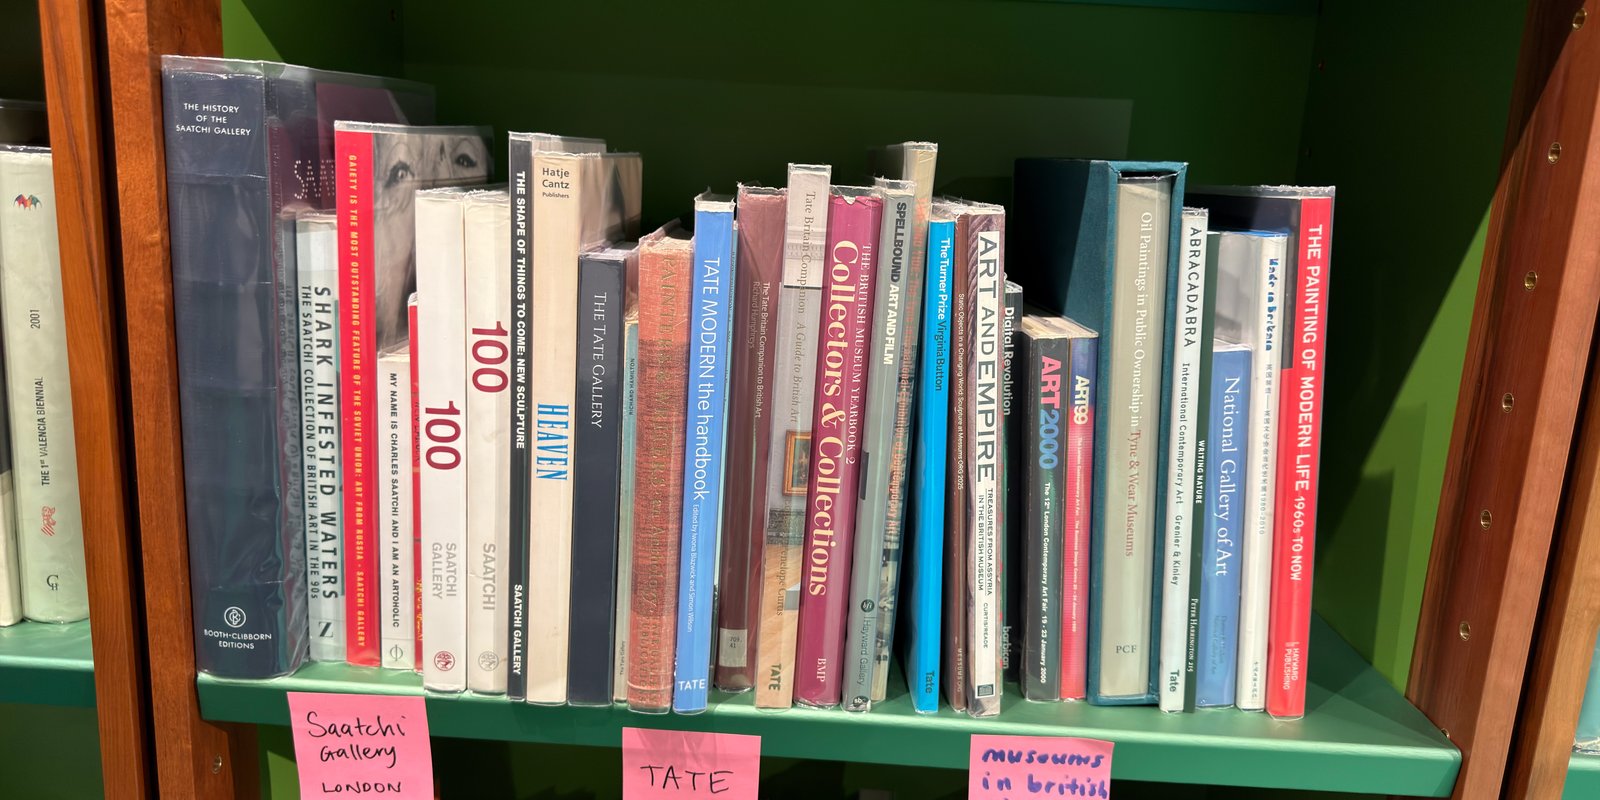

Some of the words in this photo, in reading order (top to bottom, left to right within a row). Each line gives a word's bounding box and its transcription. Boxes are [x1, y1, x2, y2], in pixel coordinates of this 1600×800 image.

[184, 103, 199, 111] THE
[202, 104, 240, 113] HISTORY
[211, 116, 227, 124] THE
[176, 124, 211, 133] SAATCHI
[214, 127, 251, 136] GALLERY
[349, 155, 358, 190] GAIETY
[517, 171, 526, 195] THE
[542, 167, 570, 179] Hatje
[542, 179, 570, 189] Cantz
[350, 195, 357, 205] IS
[350, 210, 358, 227] THE
[517, 197, 526, 236] SHAPE
[1140, 212, 1153, 231] Oil
[350, 232, 359, 257] MOST
[517, 239, 526, 255] OF
[890, 202, 907, 282] SPELLBOUND
[940, 238, 951, 259] The
[1307, 225, 1323, 260] THE
[861, 244, 872, 271] THE
[979, 236, 998, 299] ART
[1135, 235, 1151, 291] Paintings
[517, 257, 526, 300] THINGS
[703, 257, 720, 294] TATE
[762, 282, 771, 296] The
[938, 259, 950, 293] Turner
[1184, 227, 1202, 347] ABRACADABRA
[301, 285, 312, 307] THE
[351, 262, 360, 327] OUTSTANDING
[751, 281, 760, 308] Richard
[761, 298, 770, 311] Tate
[856, 274, 870, 324] BRITISH
[888, 284, 900, 309] ART
[937, 294, 948, 320] Prize
[1136, 294, 1149, 306] in
[1303, 266, 1321, 344] PAINTING
[30, 309, 41, 329] 2001
[517, 303, 526, 318] TO
[824, 241, 859, 397] Collectors
[886, 310, 898, 336] AND
[957, 312, 965, 335] Objects
[302, 313, 313, 363] SAATCHI
[314, 286, 333, 367] SHARK
[516, 320, 526, 355] COME:
[699, 299, 718, 378] MODERN
[934, 320, 947, 356] Virginia
[981, 306, 995, 356] AND
[1134, 309, 1147, 346] Public
[352, 331, 361, 371] FEATURE
[473, 321, 509, 393] 100
[852, 328, 866, 383] MUSEUM
[883, 337, 895, 365] FILM
[956, 347, 965, 376] Changing
[1301, 349, 1316, 371] OF
[353, 374, 361, 386] OF
[390, 373, 398, 387] MY
[516, 358, 525, 384] NEW
[935, 358, 946, 392] Button
[1003, 351, 1014, 417] Revolution
[1128, 349, 1146, 413] Ownership
[304, 370, 316, 440] COLLECTION
[353, 390, 361, 407] THE
[390, 390, 398, 417] NAME
[698, 383, 715, 410] the
[755, 385, 765, 406] British
[516, 385, 525, 448] SCULPTURE
[821, 402, 847, 429] &
[847, 387, 861, 452] YEARBOOK
[956, 397, 964, 425] Sculpture
[977, 361, 996, 483] EMPIRE
[1131, 416, 1142, 427] in
[1220, 376, 1241, 452] National
[1297, 377, 1315, 448] MODERN
[37, 417, 48, 458] VALENCIA
[354, 411, 362, 442] SOVIET
[391, 421, 398, 430] IS
[425, 400, 462, 471] 100
[306, 446, 316, 460] OF
[317, 383, 335, 497] INFESTED
[536, 403, 571, 481] HEAVEN
[1128, 430, 1142, 458] Tyne
[354, 446, 363, 477] UNION:
[391, 433, 399, 476] CHARLES
[693, 416, 714, 500] handbook
[1129, 460, 1140, 470] &
[1175, 424, 1187, 487] Contemporary
[1197, 440, 1206, 473] WRITING
[41, 470, 50, 486] THE
[307, 465, 318, 509] BRITISH
[1128, 473, 1139, 501] Wear
[1295, 455, 1311, 491] LIFE
[355, 481, 363, 497] ART
[391, 478, 400, 517] SAATCHI
[978, 495, 986, 505] IN
[1176, 490, 1184, 505] Art
[1195, 475, 1204, 504] NATURE
[1213, 459, 1237, 521] Gallery
[309, 514, 318, 535] ART
[355, 502, 364, 525] FROM
[809, 437, 844, 596] Collections
[978, 505, 986, 521] THE
[1043, 511, 1051, 536] London
[391, 519, 399, 539] AND
[1125, 504, 1138, 557] Museums
[1173, 515, 1183, 548] Grenier
[1215, 527, 1233, 547] of
[309, 540, 318, 552] IN
[320, 511, 338, 600] WATERS
[356, 529, 364, 560] RUSSIA
[392, 547, 400, 561] AM
[986, 538, 994, 561] FROM
[1292, 536, 1304, 552] TO
[310, 557, 319, 576] THE
[392, 563, 400, 577] AN
[432, 542, 444, 599] GALLERY
[446, 543, 458, 597] SAATCHI
[1041, 537, 1050, 584] Contemporary
[1214, 549, 1232, 577] Art
[1290, 556, 1303, 581] NOW
[311, 581, 320, 600] 90s
[357, 571, 365, 607] SAATCHI
[482, 543, 497, 611] SAATCHI
[689, 580, 697, 592] and
[392, 580, 400, 628] ARTOHOLIC
[513, 585, 523, 627] SAATCHI
[357, 610, 366, 646] GALLERY
[219, 640, 255, 650] EDITIONS
[513, 630, 522, 675] GALLERY
[1040, 639, 1048, 665] January
[1116, 644, 1137, 654] PCF
[769, 663, 782, 691] TATE
[816, 658, 827, 682] BMP
[1283, 648, 1292, 690] PUBLISHING
[1291, 648, 1300, 681] HAYWARD
[677, 679, 706, 691] TATE
[925, 670, 935, 694] Tate
[1169, 669, 1180, 693] Tate
[306, 710, 407, 738] Saatchi
[320, 744, 397, 769] Gallery
[640, 765, 734, 795] TATE
